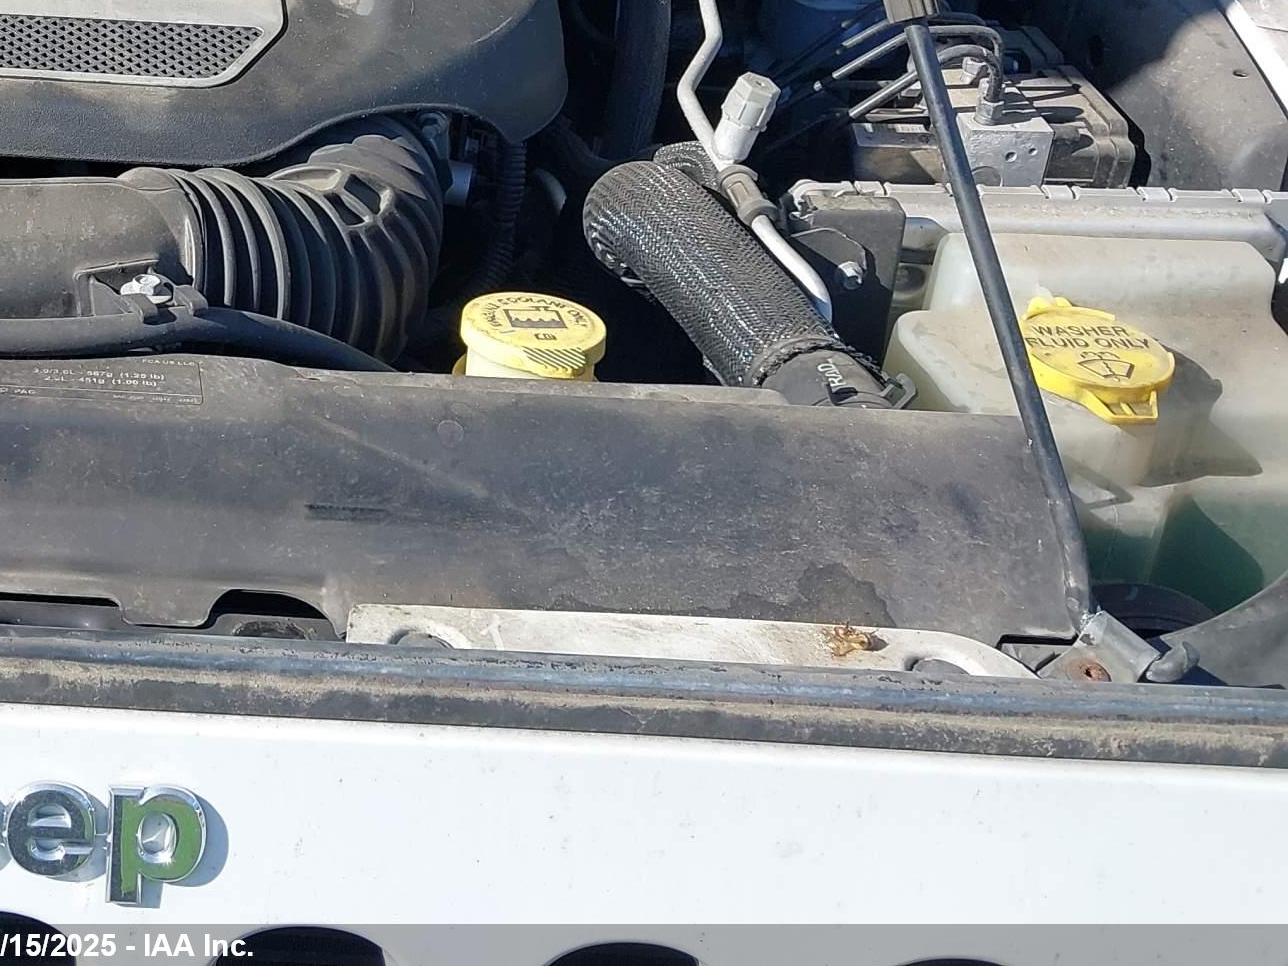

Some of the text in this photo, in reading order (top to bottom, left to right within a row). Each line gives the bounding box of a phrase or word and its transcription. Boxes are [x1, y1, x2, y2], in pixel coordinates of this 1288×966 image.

[1032, 325, 1130, 337] WASHER
[1025, 336, 1150, 349] FLUID ONLY
[86, 370, 113, 378] 567g
